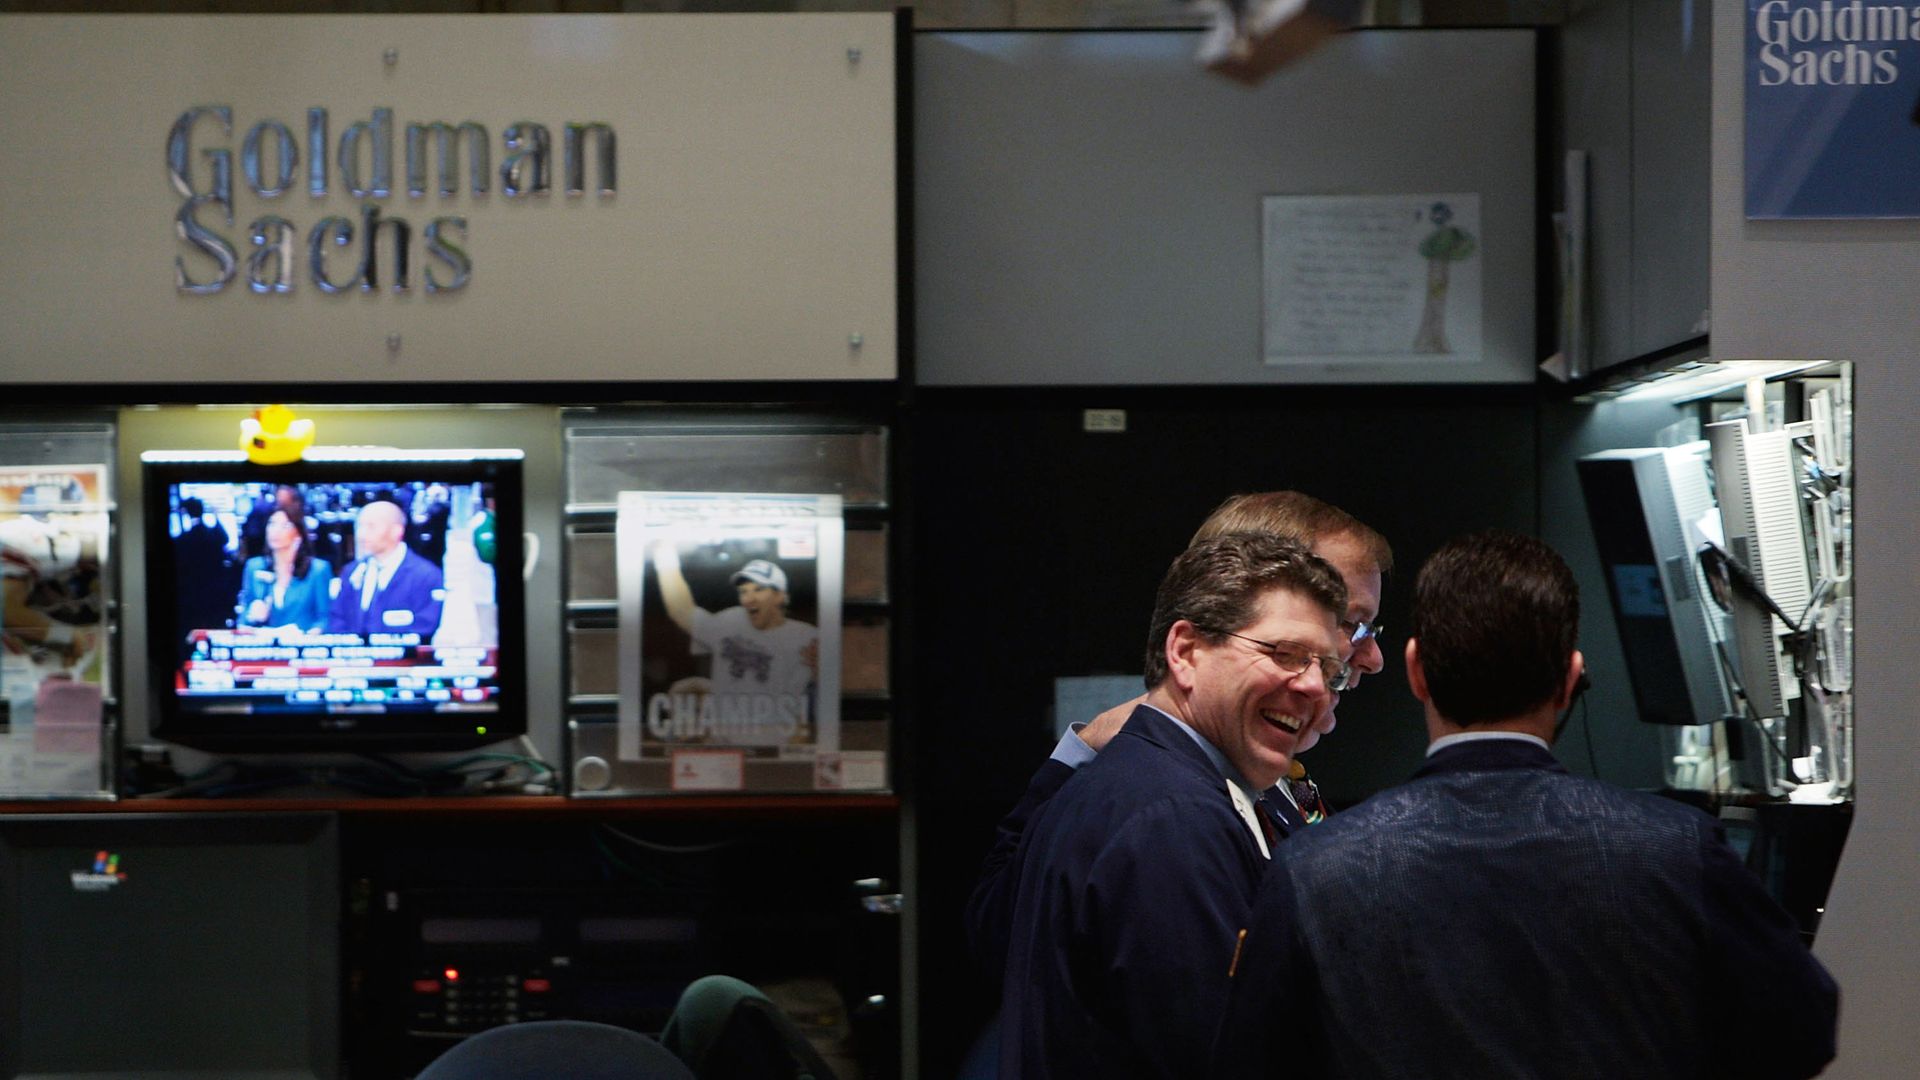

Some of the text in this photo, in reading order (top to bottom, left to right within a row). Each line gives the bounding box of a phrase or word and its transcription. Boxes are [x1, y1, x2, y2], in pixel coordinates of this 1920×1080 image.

[1758, 43, 1899, 86] Sachs
[166, 105, 618, 215] Goldman
[175, 200, 474, 296] Sachs
